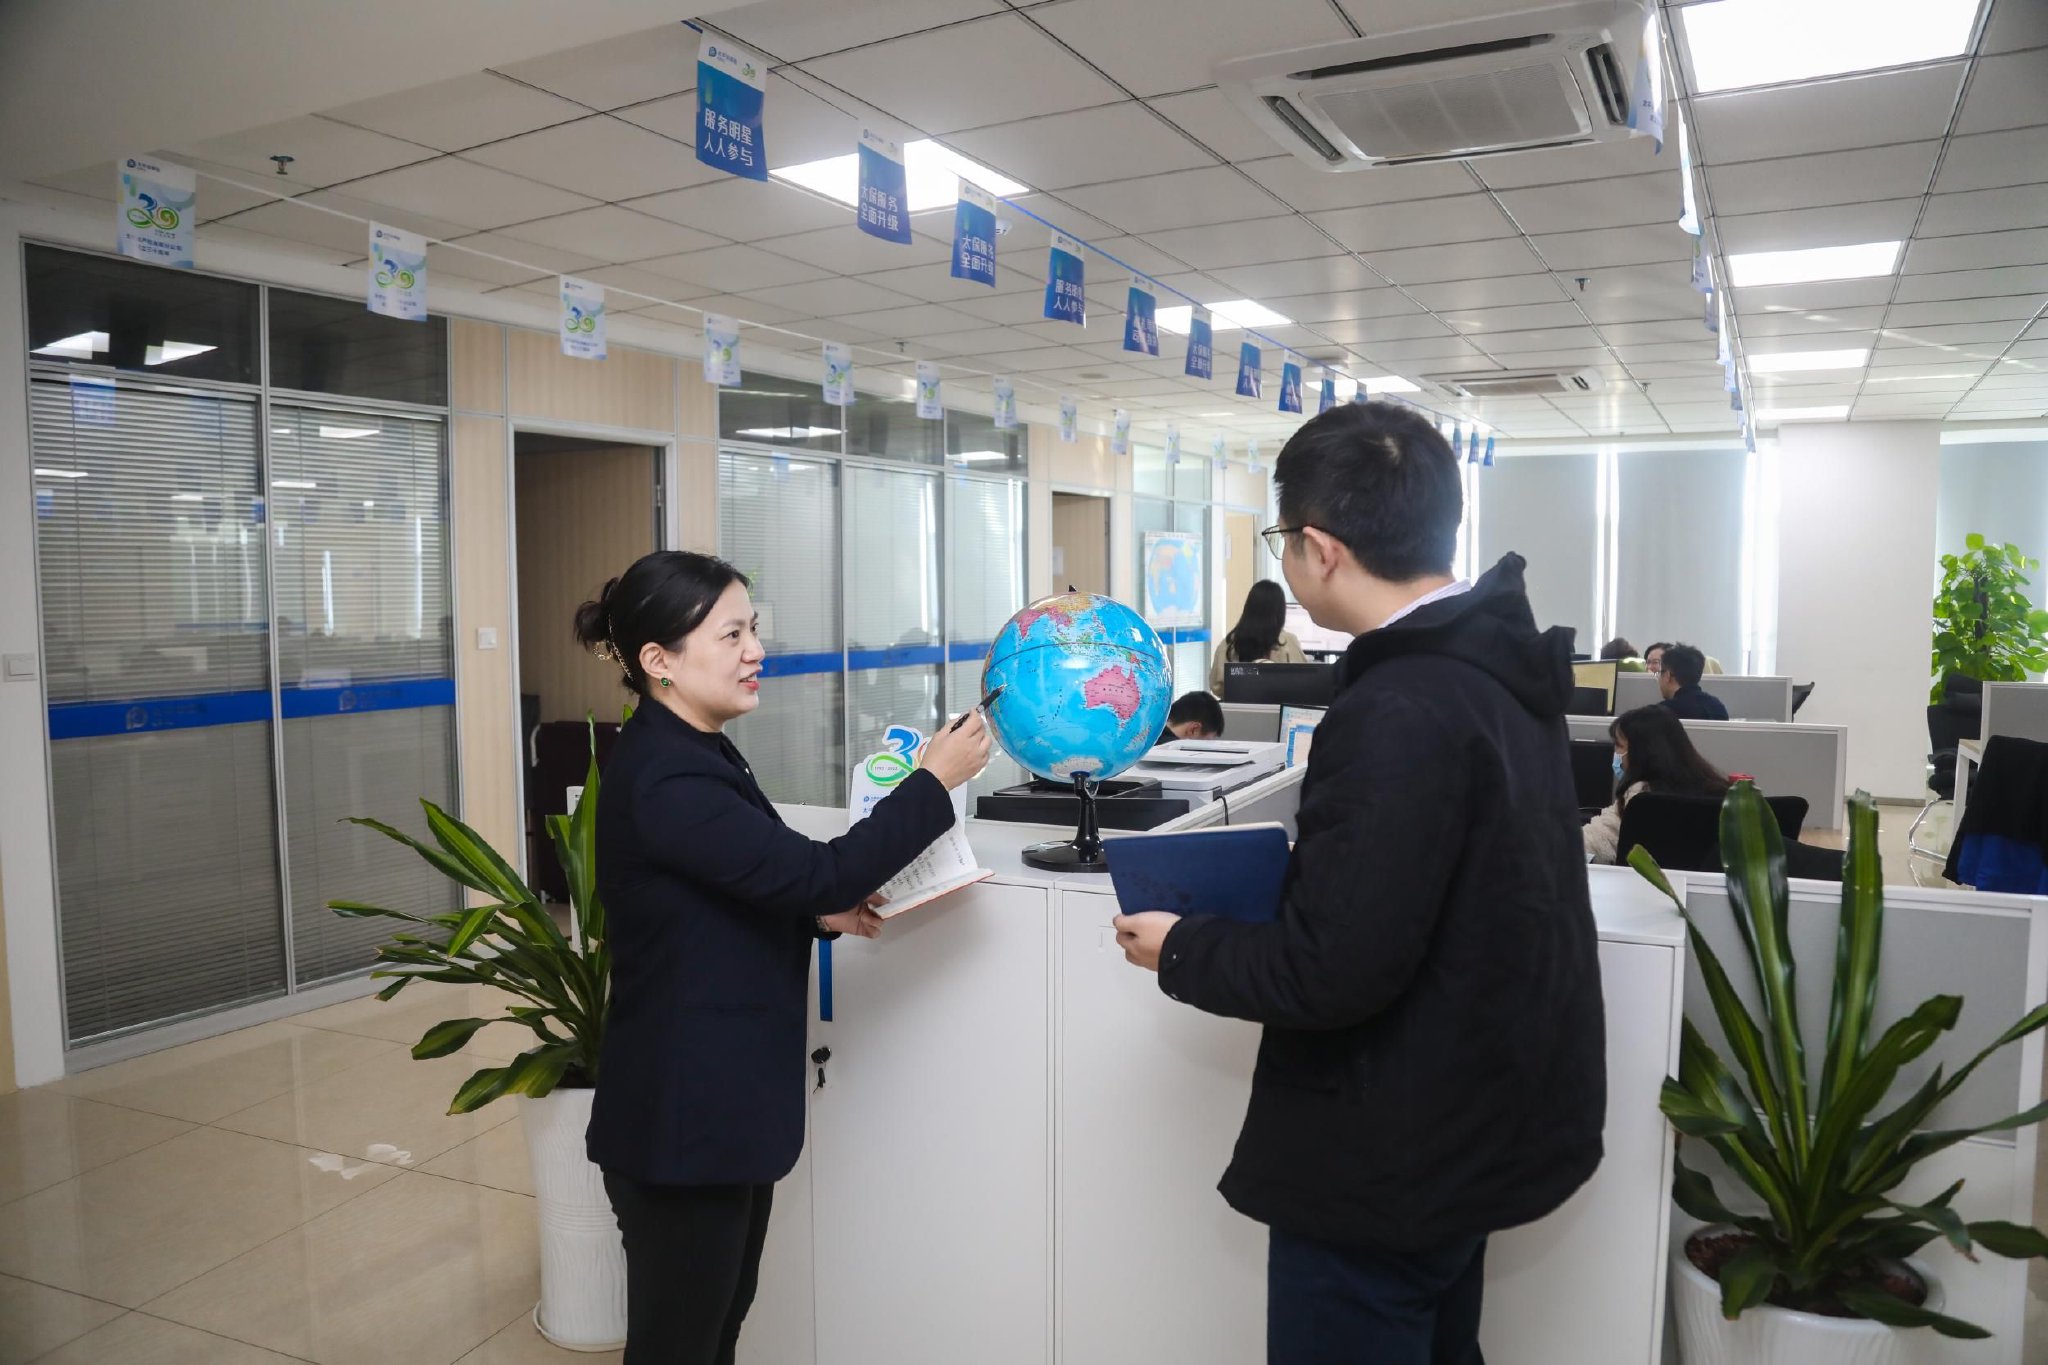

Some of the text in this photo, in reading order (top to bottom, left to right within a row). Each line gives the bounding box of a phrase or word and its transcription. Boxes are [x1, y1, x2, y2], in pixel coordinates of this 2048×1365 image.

[704, 107, 753, 147] 服务明星
[704, 132, 753, 167] 人人参与
[861, 184, 898, 213] 太保服务
[860, 204, 899, 232] 全面升级
[962, 234, 994, 259] 太保服务
[960, 253, 994, 277] 全面升级
[1053, 296, 1084, 316] 人人参与
